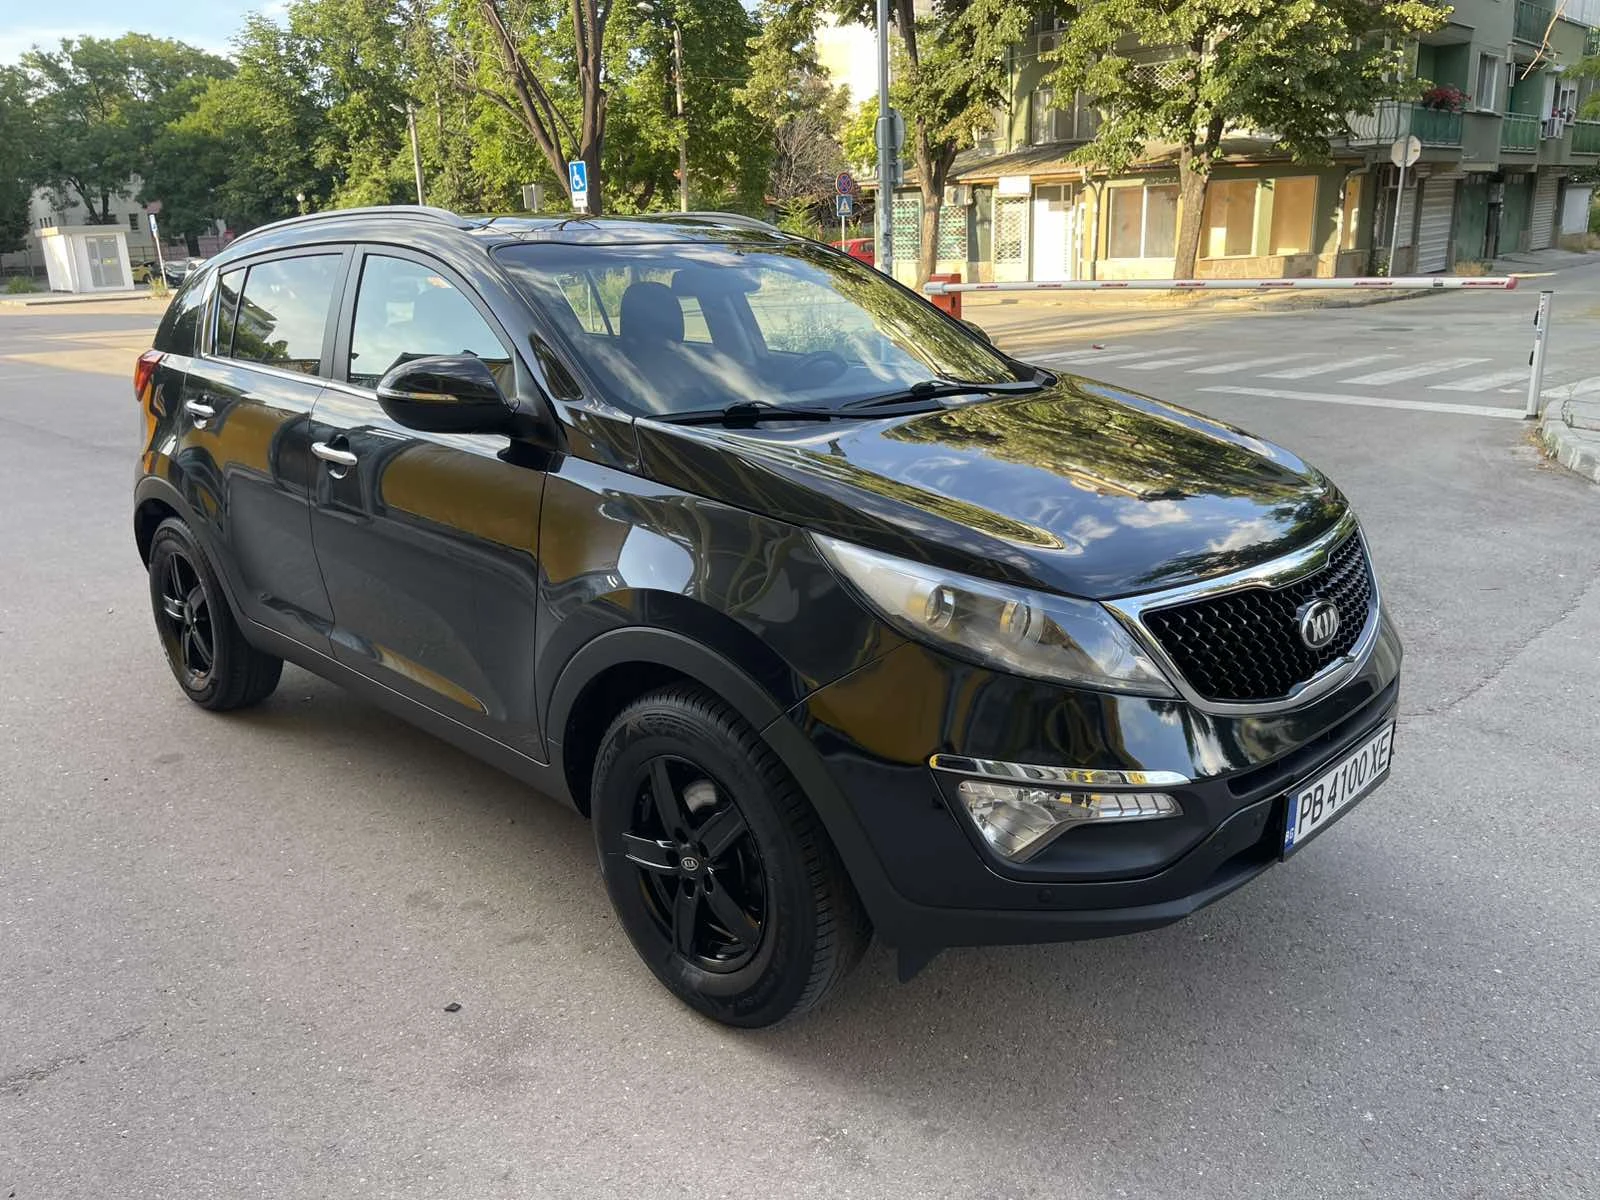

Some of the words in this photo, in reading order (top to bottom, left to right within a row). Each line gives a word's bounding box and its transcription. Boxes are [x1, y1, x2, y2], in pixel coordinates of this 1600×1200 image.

[1311, 608, 1338, 642] KIA
[1298, 783, 1325, 834] PB
[1327, 751, 1368, 809] 4100
[1369, 732, 1390, 779] XE
